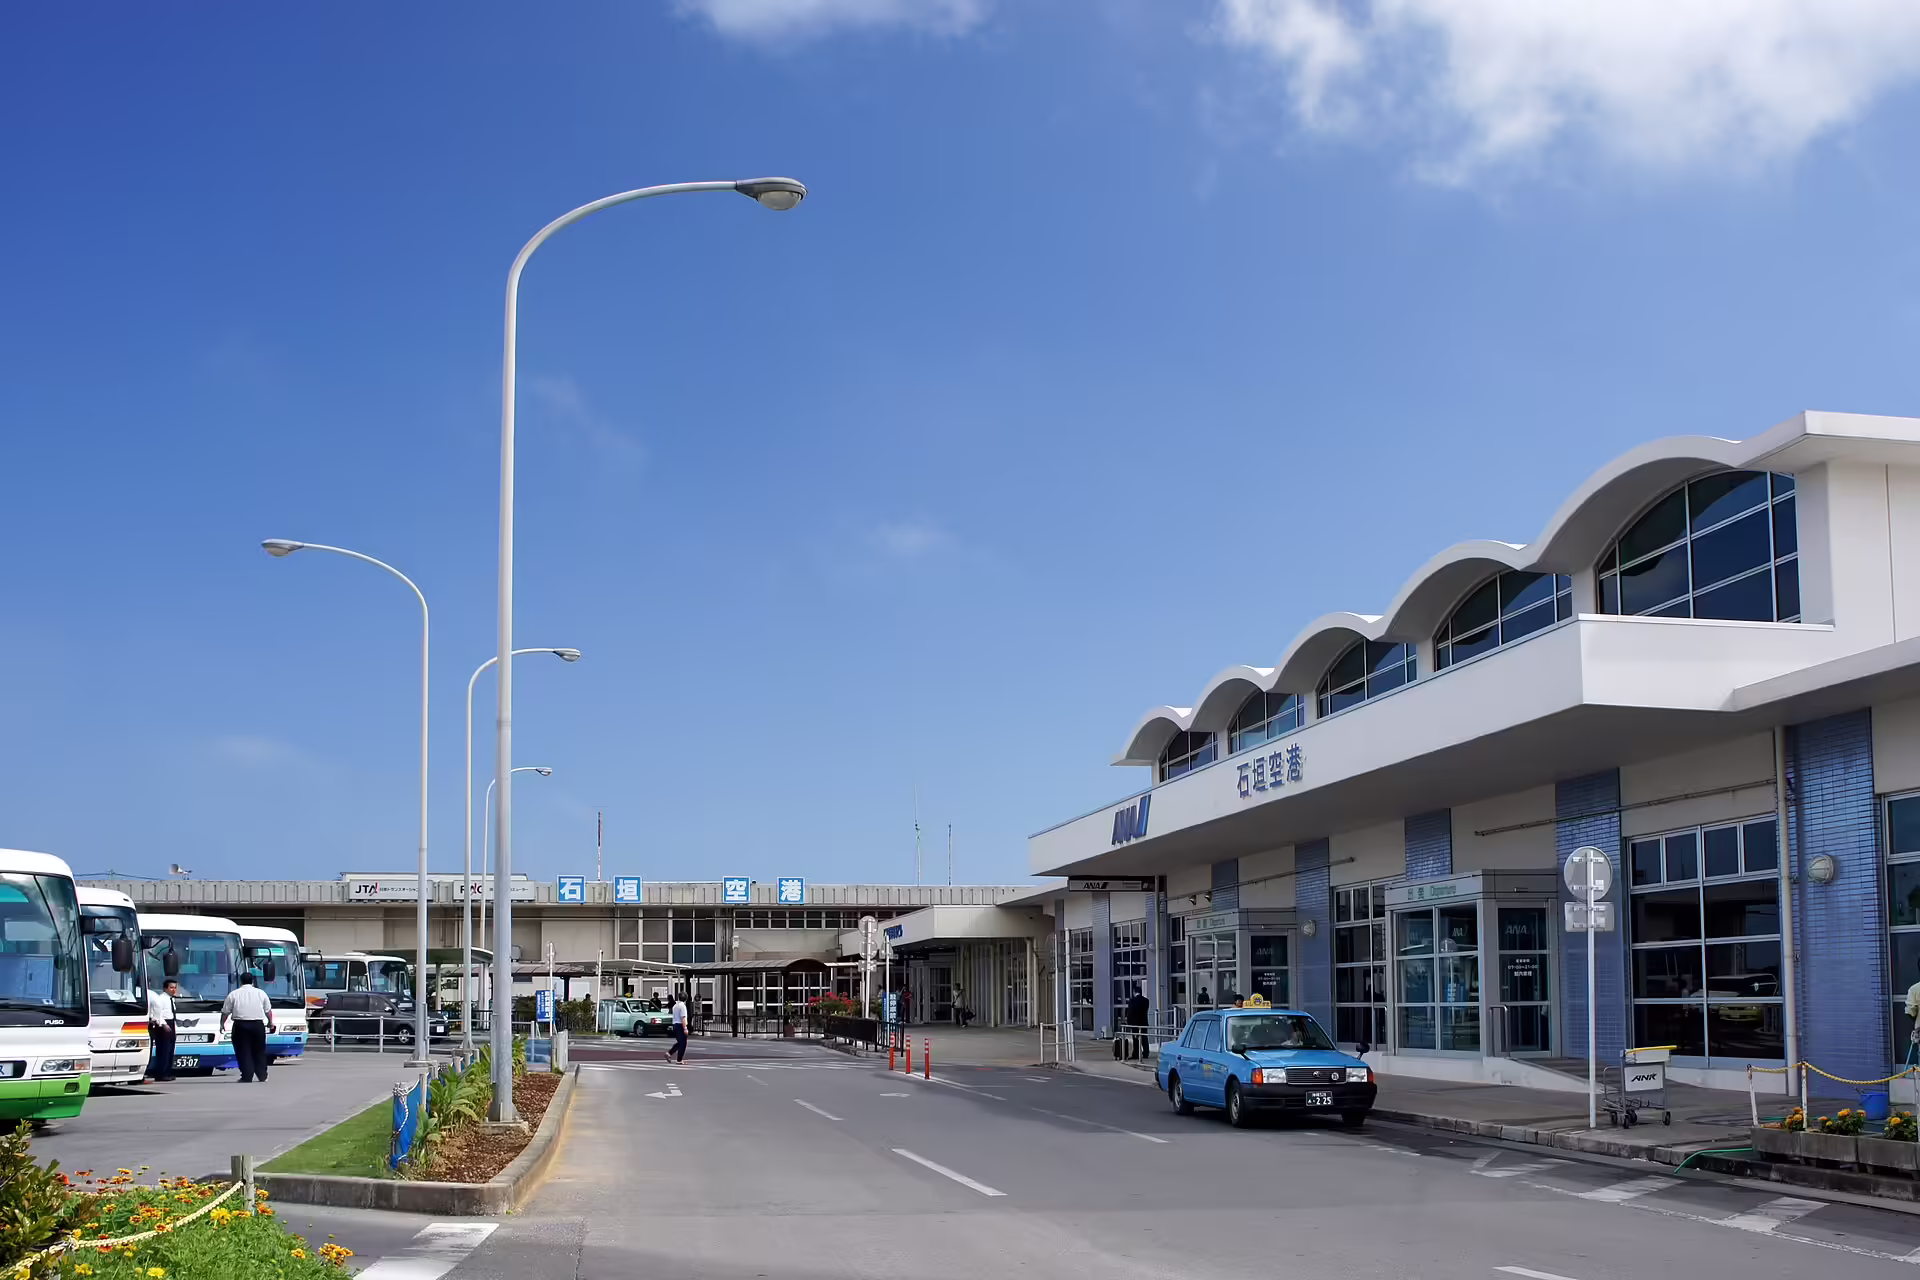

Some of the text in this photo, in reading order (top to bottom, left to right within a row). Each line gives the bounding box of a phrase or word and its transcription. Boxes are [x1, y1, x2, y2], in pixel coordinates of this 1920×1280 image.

[1237, 743, 1304, 799] 石垣空港
[355, 882, 378, 896] JTA
